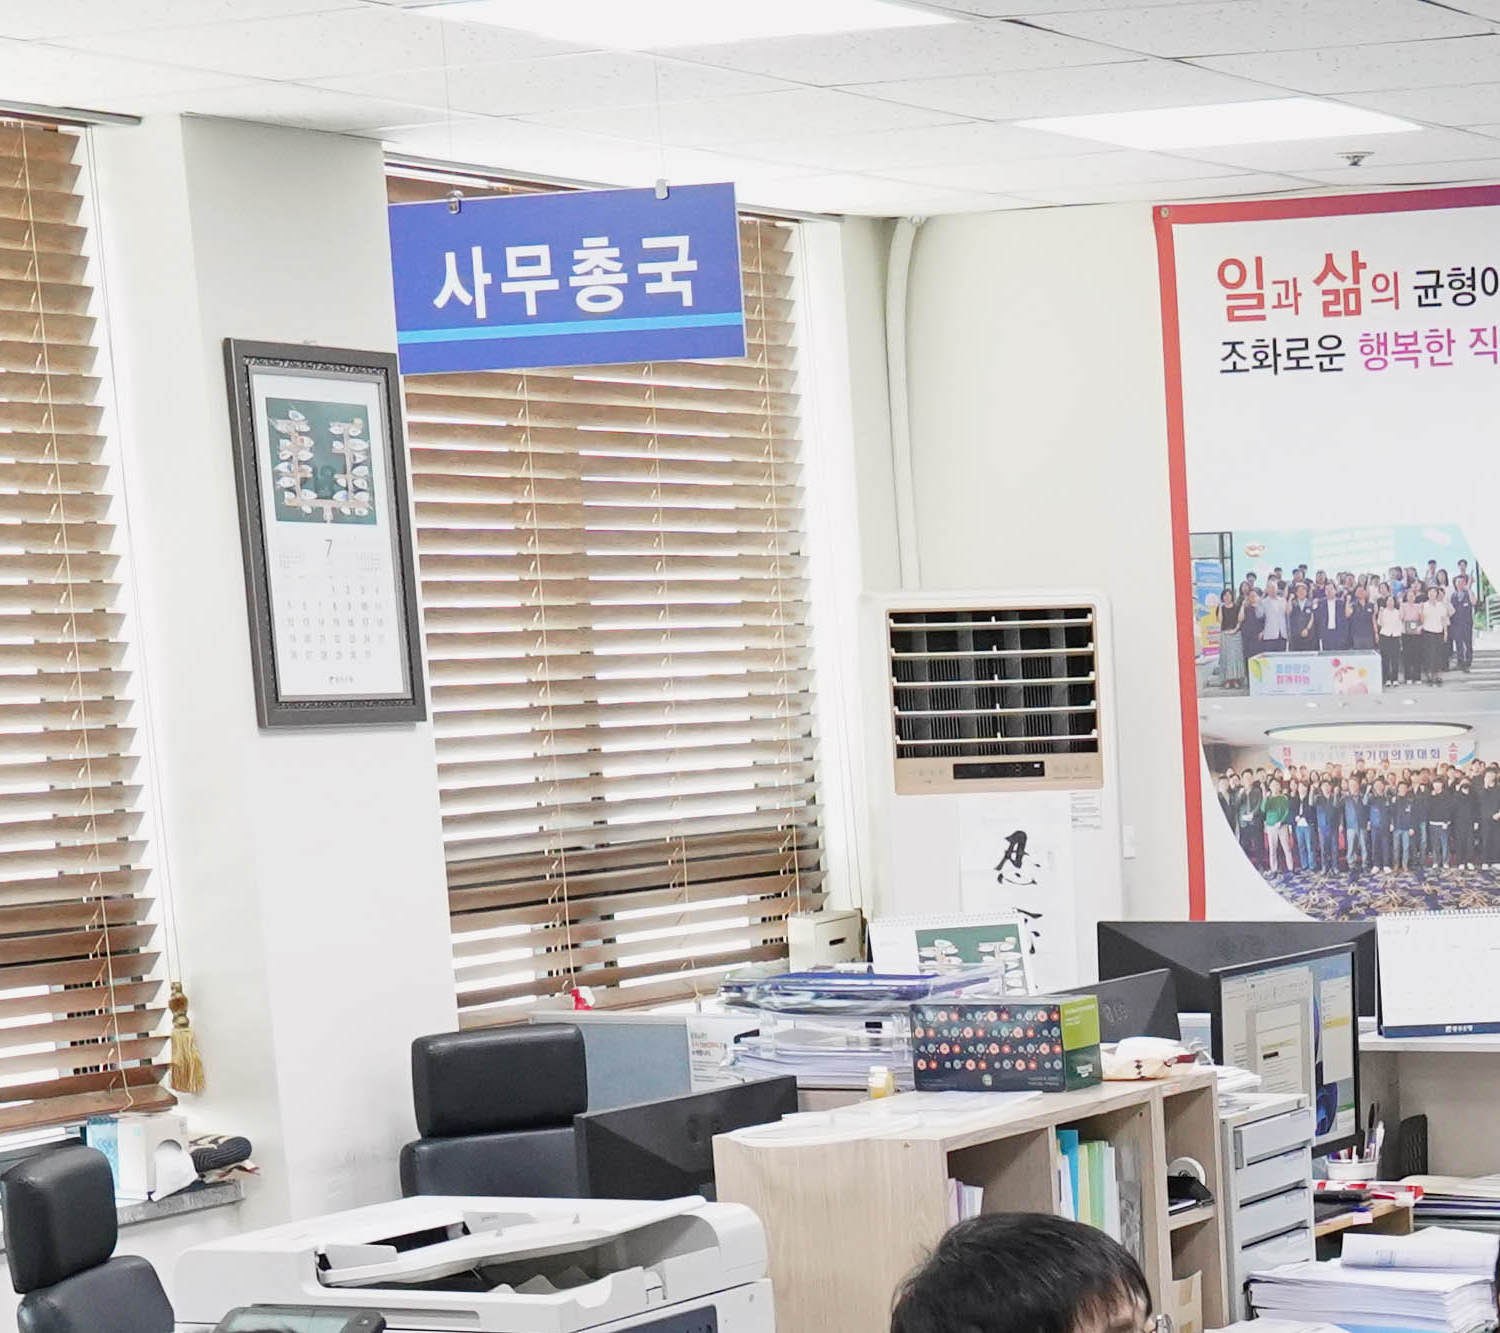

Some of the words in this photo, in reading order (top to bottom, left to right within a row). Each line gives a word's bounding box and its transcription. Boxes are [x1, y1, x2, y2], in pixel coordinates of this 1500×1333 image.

[433, 234, 699, 319] 사무총국
[1215, 253, 1304, 324] 일과
[1312, 248, 1402, 320] 삶의
[1218, 332, 1345, 377] 조화로운
[1357, 327, 1457, 373] 행복한
[325, 539, 333, 558] 7
